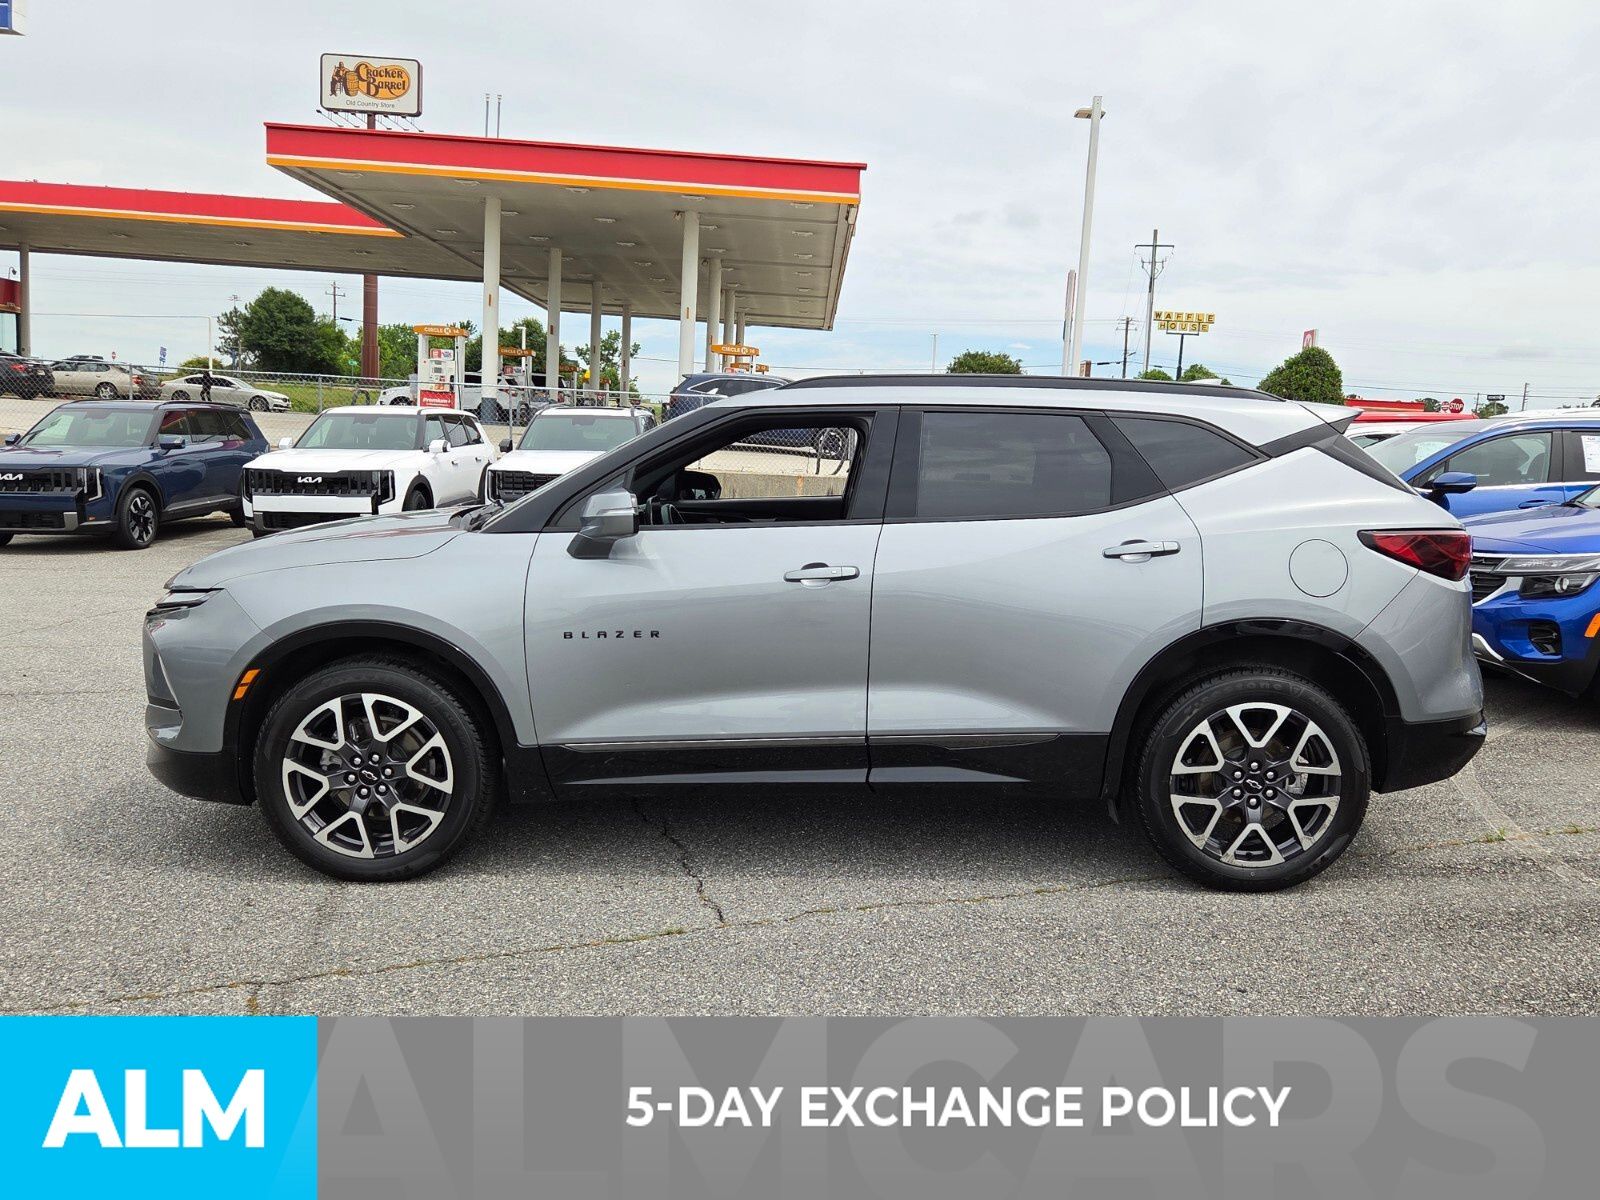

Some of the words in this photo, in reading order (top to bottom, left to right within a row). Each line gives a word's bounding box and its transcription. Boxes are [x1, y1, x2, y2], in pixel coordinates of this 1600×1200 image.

[357, 100, 379, 109] Country
[1154, 311, 1214, 322] WAFFLE
[1159, 322, 1207, 331] HOUSE
[1449, 402, 1463, 410] STOP
[297, 476, 322, 484] KIA
[563, 630, 660, 639] BLAZER
